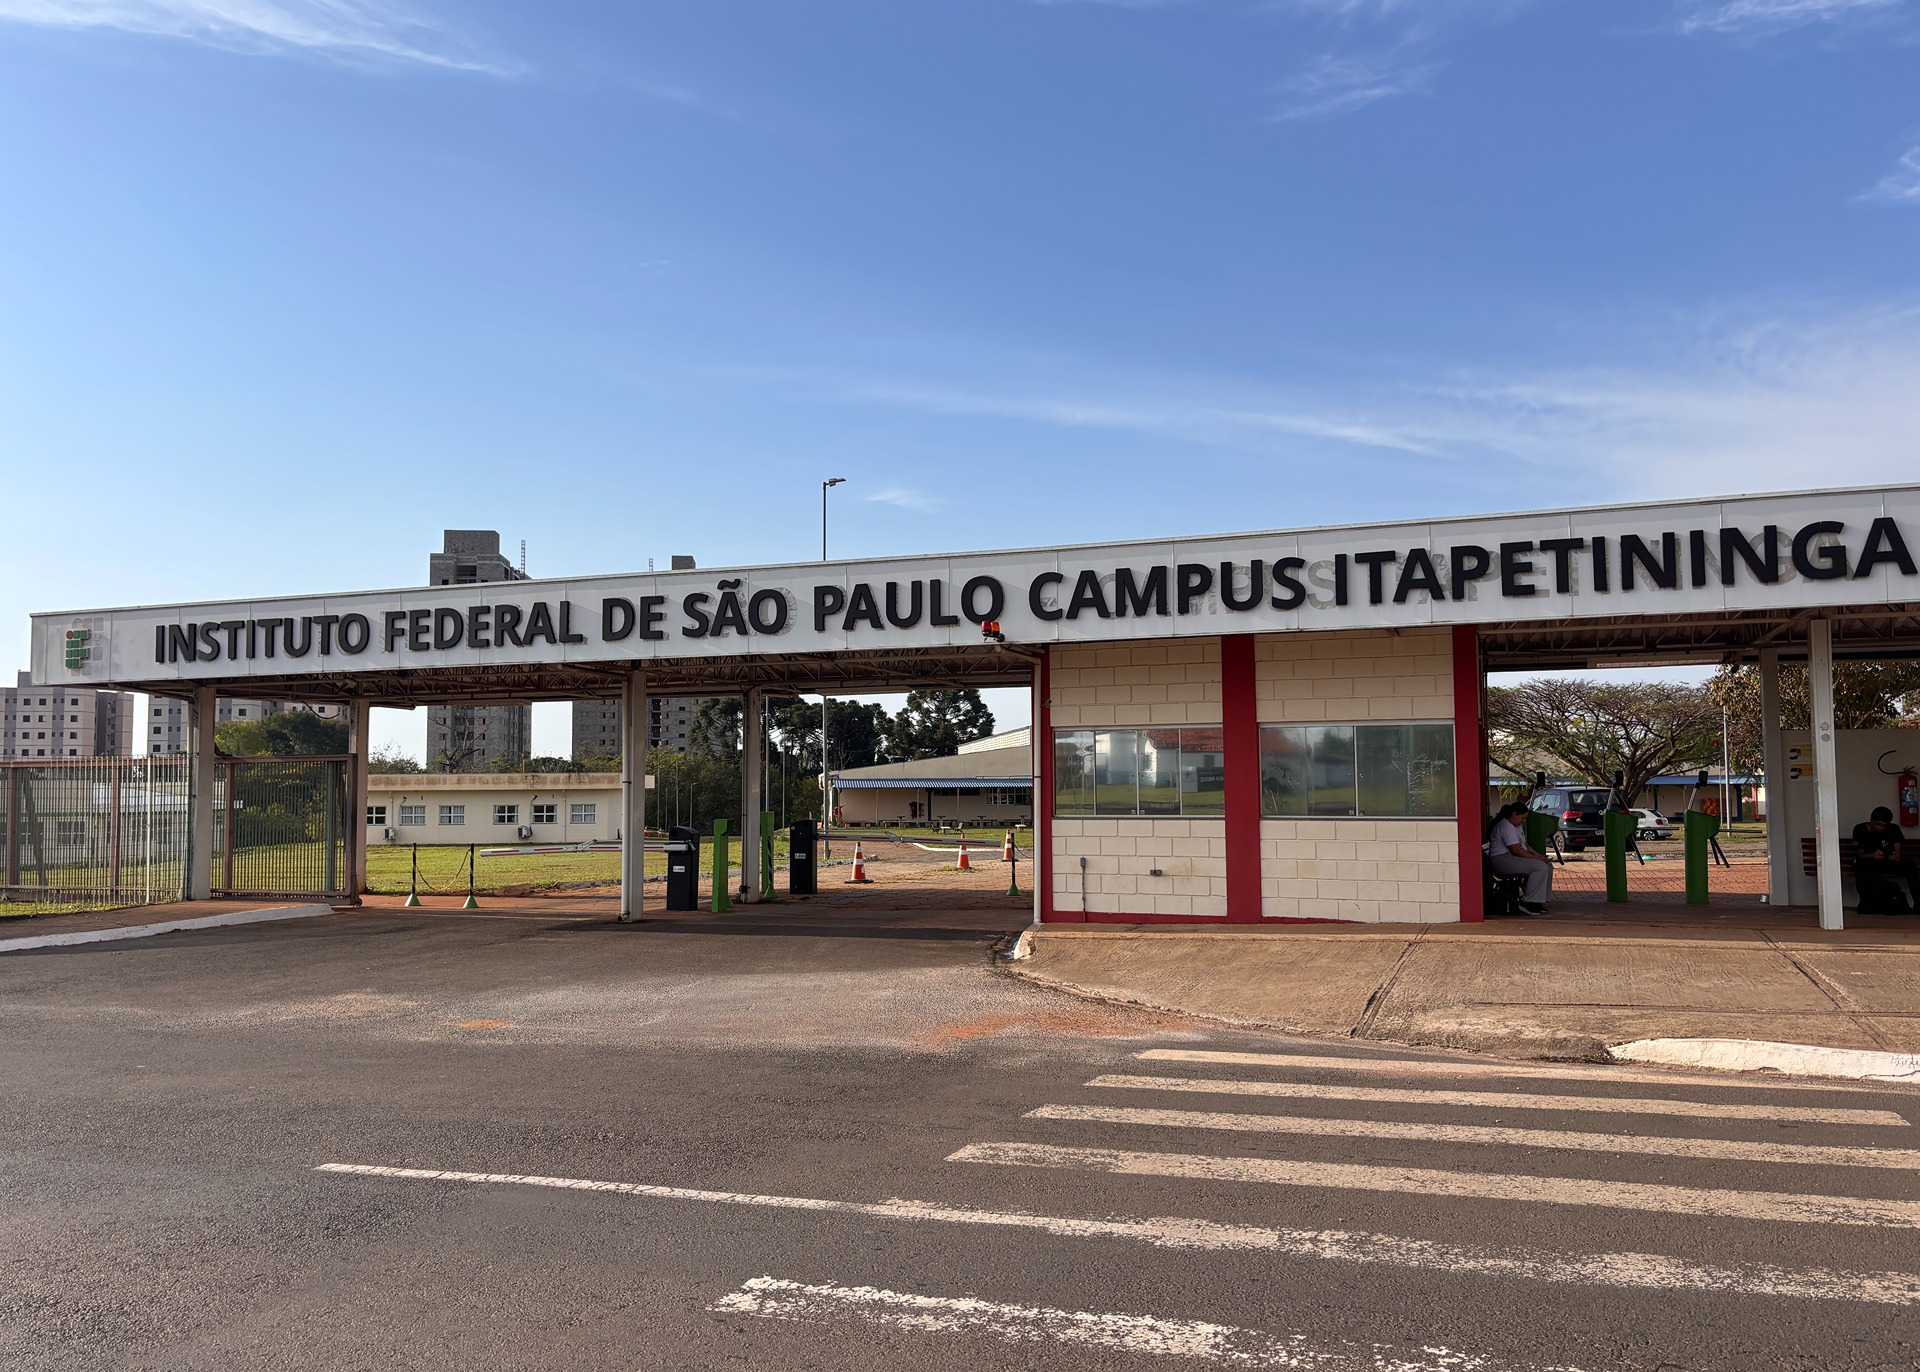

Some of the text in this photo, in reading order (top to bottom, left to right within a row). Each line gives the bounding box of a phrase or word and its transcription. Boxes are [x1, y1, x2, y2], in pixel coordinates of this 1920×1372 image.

[155, 516, 1919, 664] INSTITUTO FEDERAL DE SÃO PAULO CAMPUS ITAPETININGA
